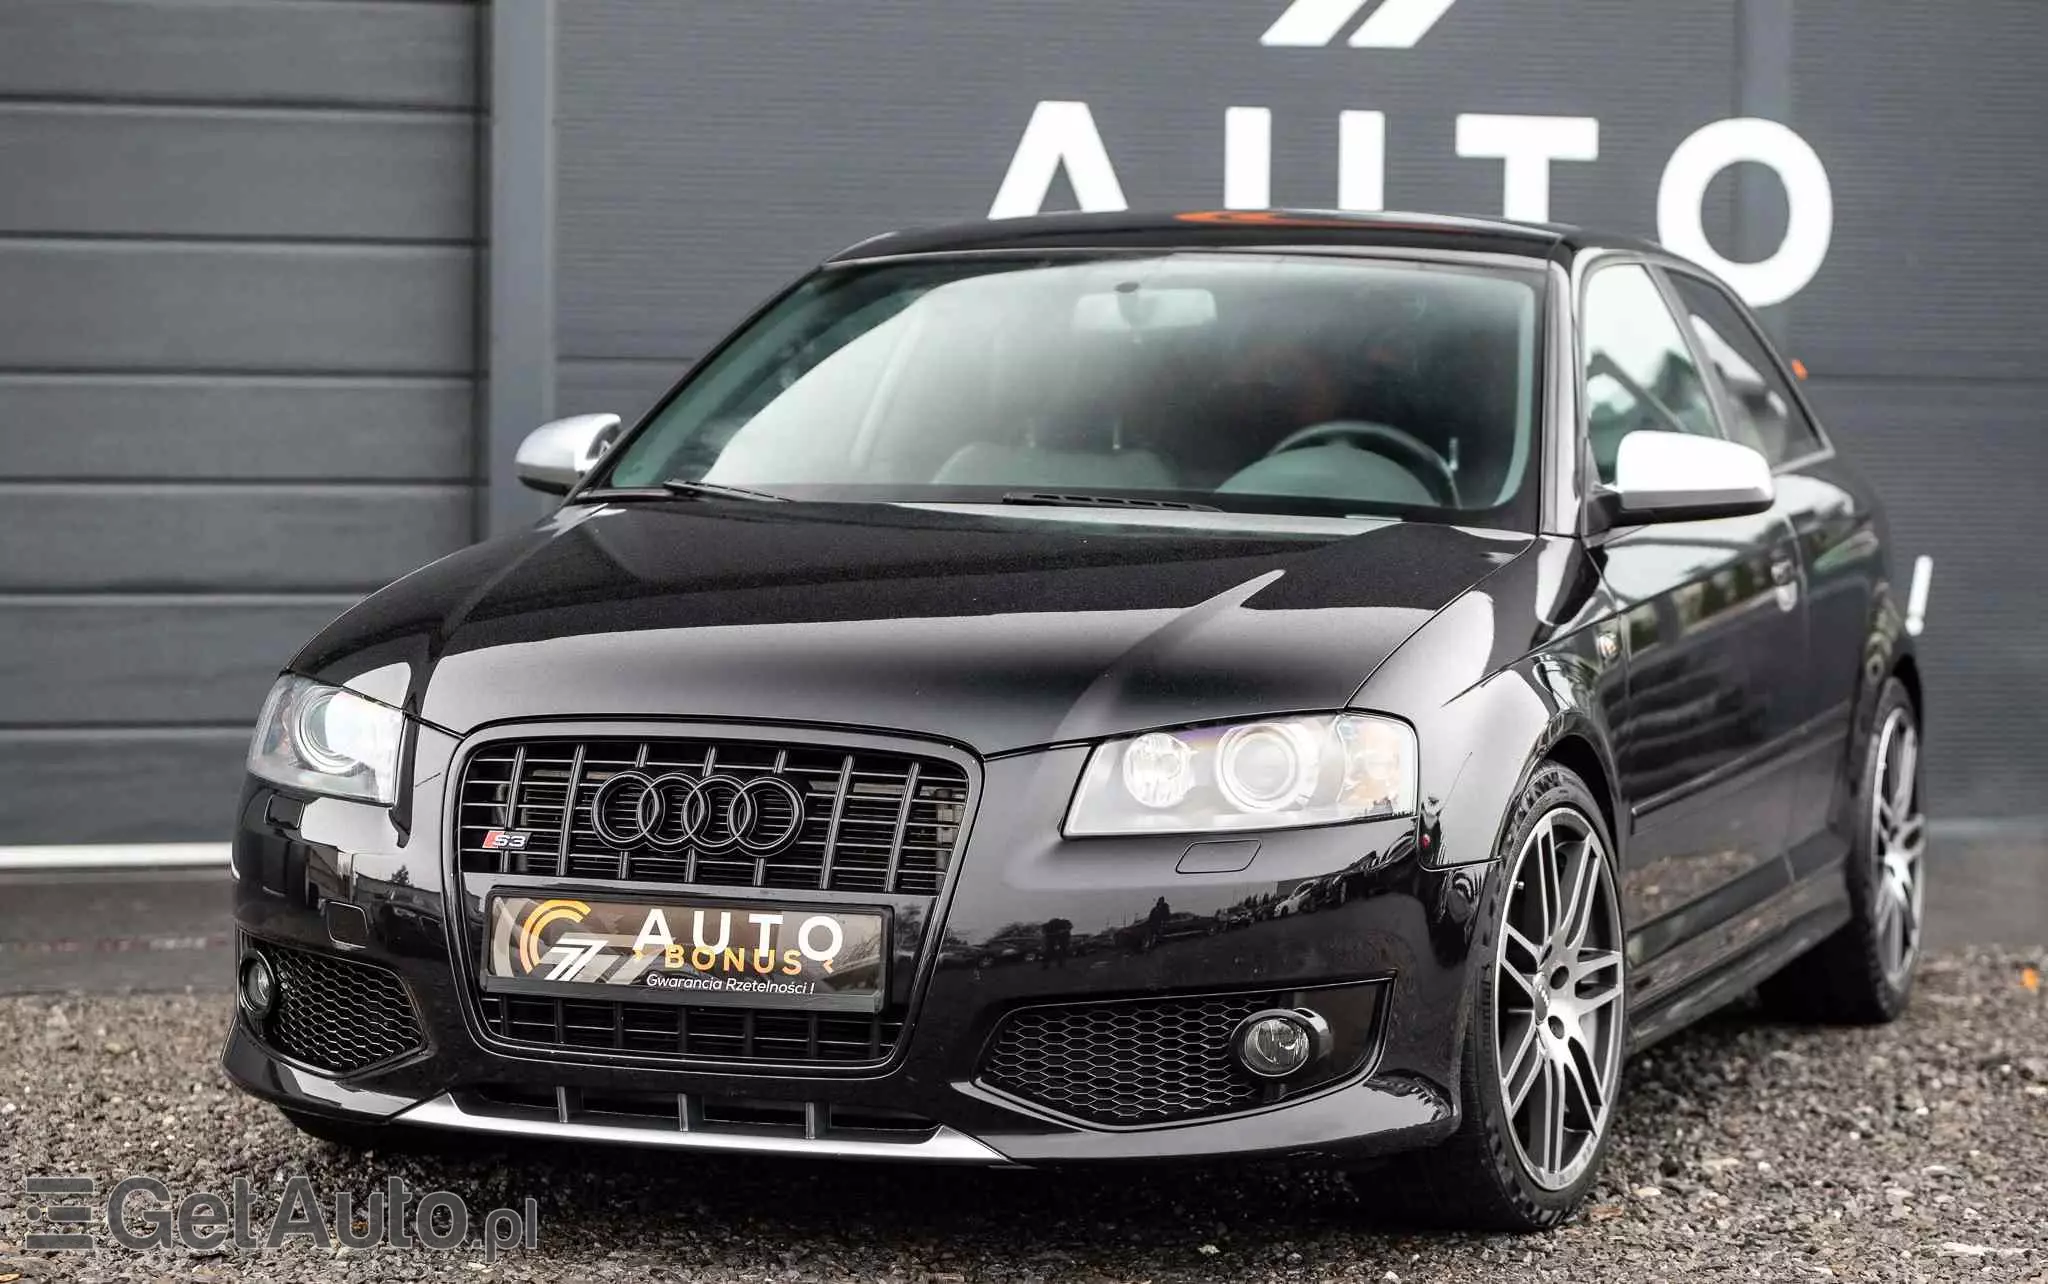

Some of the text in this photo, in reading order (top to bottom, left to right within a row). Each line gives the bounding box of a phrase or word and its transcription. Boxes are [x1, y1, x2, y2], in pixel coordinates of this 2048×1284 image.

[987, 100, 1833, 307] AUTO
[493, 834, 526, 848] S3
[631, 908, 843, 962] AUTO
[664, 943, 802, 976] BONUS
[646, 973, 723, 991] Gwarancja
